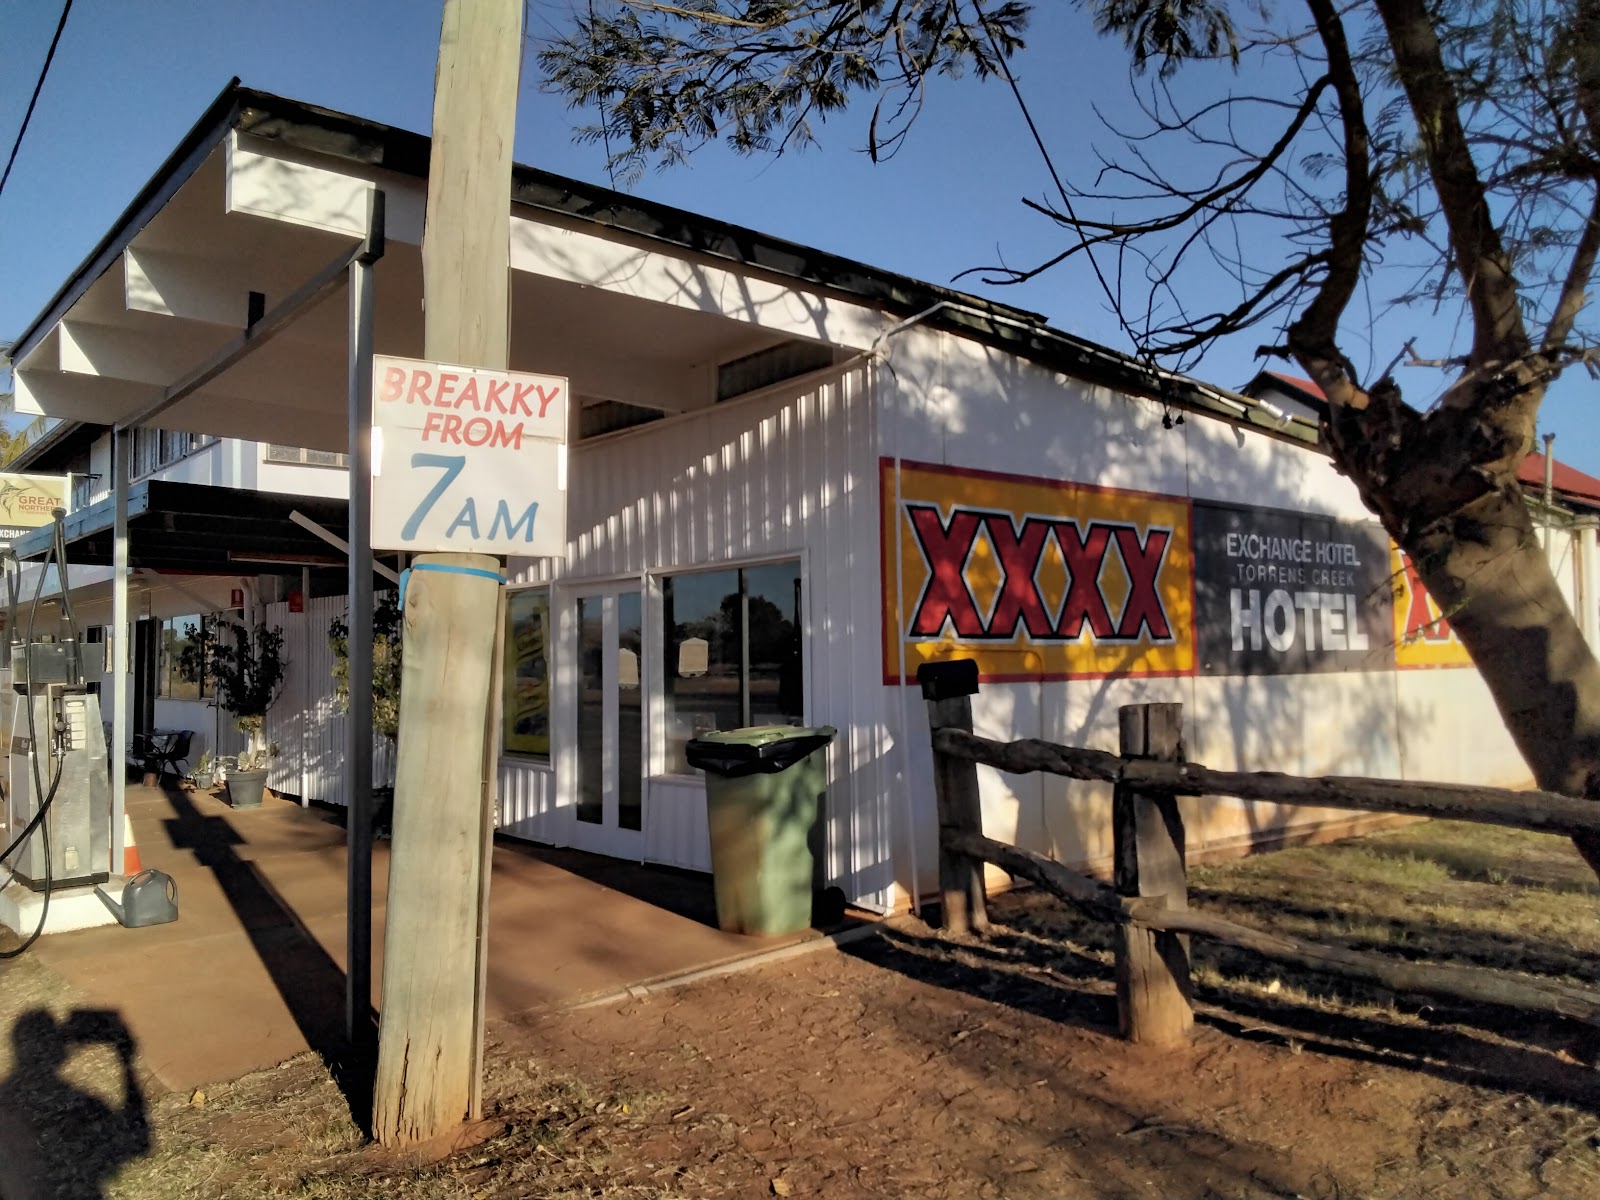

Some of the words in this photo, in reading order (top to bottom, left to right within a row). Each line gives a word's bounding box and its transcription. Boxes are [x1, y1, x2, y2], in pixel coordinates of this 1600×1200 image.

[380, 367, 560, 418] BREAKKY
[421, 412, 524, 450] FROM
[19, 496, 61, 506] GREAT
[1226, 533, 1312, 563] EXCHANGE
[1315, 542, 1361, 567] HOTEL
[903, 501, 1173, 643] XXXX
[1237, 563, 1306, 585] TORRENS
[1312, 568, 1355, 586] CREEK
[1230, 588, 1369, 652] HOTEL
